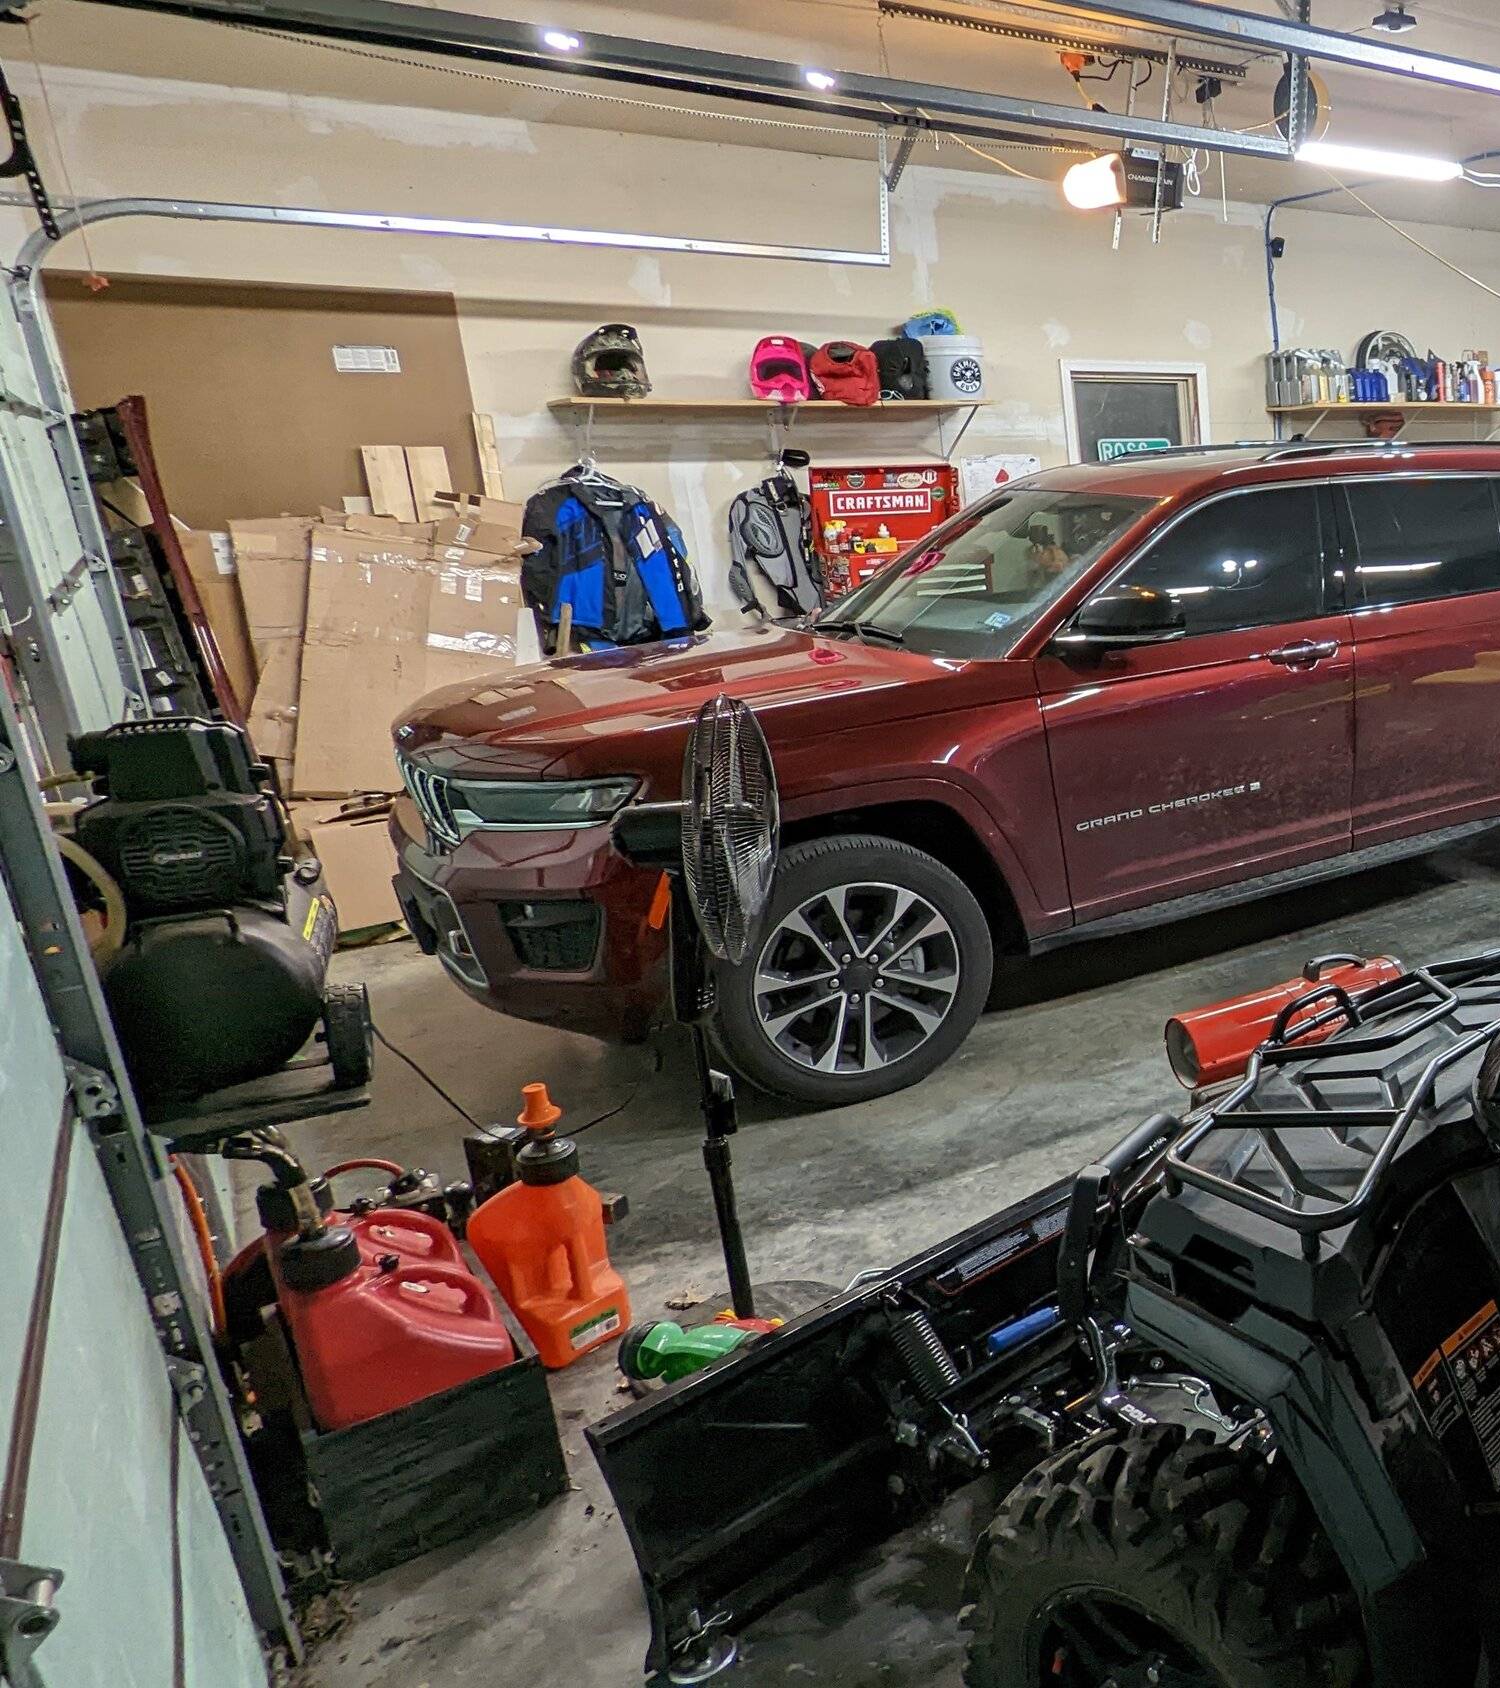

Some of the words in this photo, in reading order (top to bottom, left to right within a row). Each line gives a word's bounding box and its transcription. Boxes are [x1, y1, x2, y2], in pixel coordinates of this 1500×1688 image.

[836, 494, 926, 511] CRAFTSMAN
[1076, 808, 1142, 832] GRAND
[1148, 785, 1245, 813] CHEROKEE
